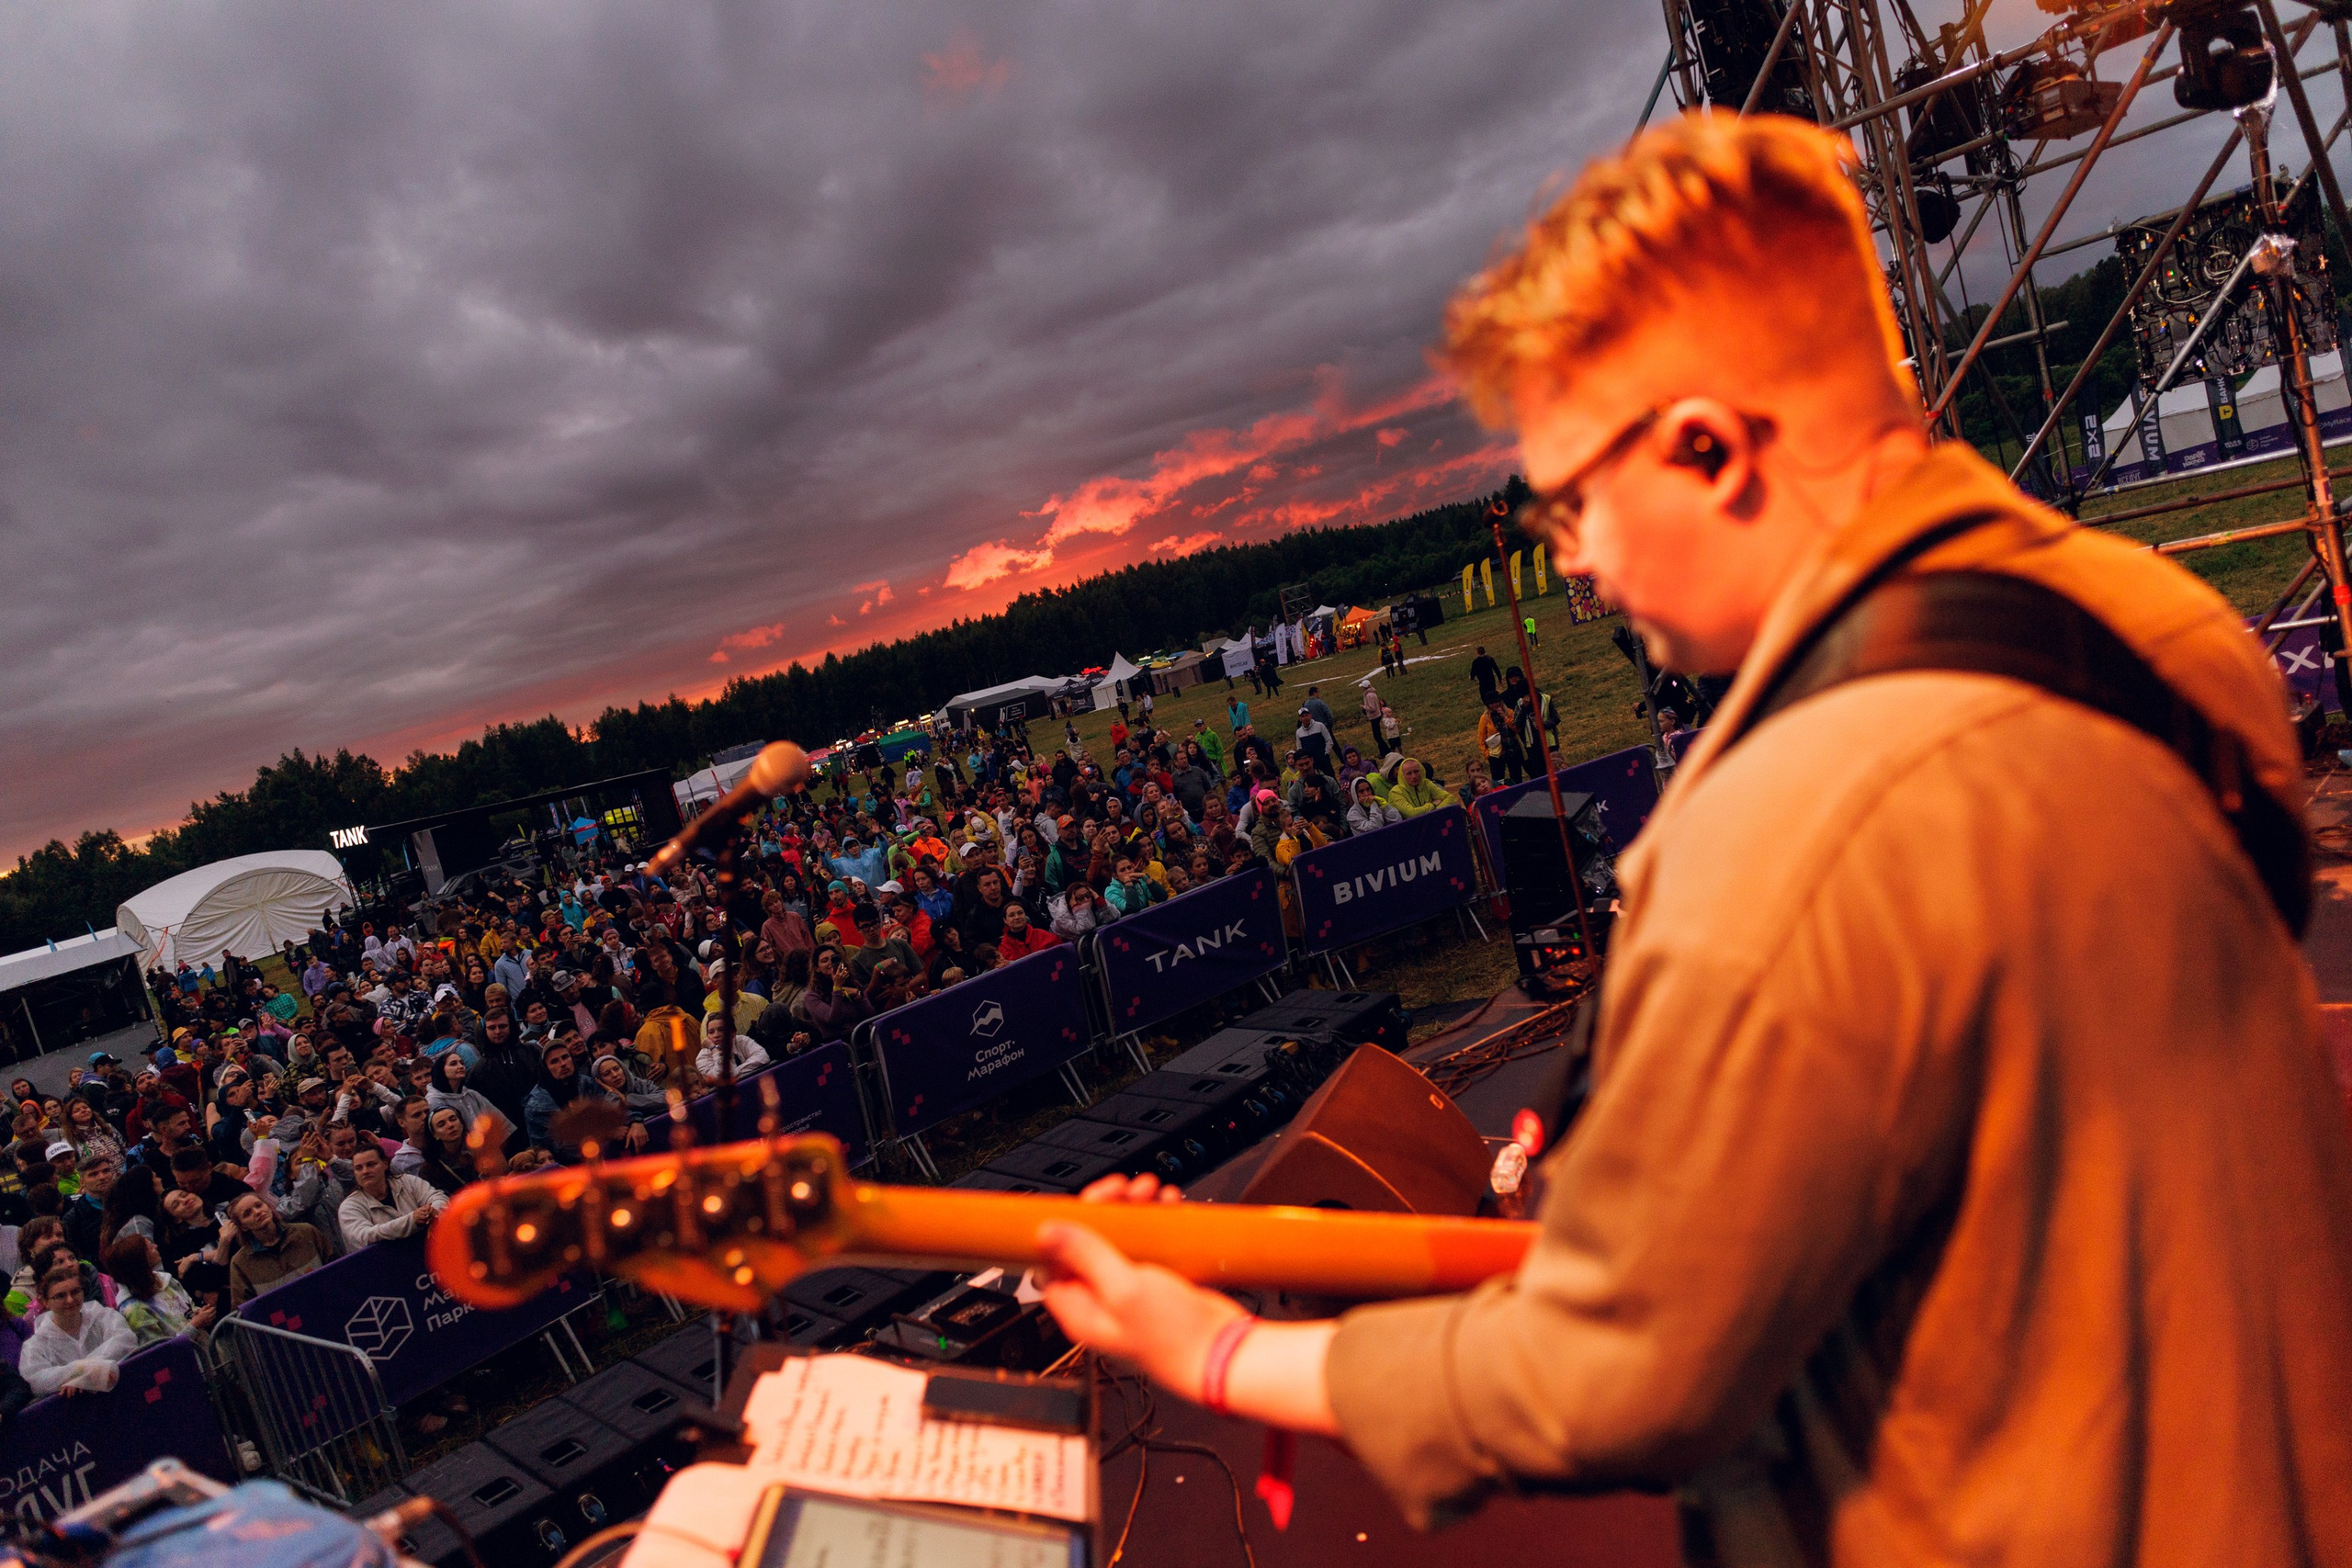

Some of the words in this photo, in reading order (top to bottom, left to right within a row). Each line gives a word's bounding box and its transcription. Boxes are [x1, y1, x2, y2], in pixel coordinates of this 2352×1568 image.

[2217, 377, 2228, 404] БАНК
[330, 825, 368, 850] TANK
[1332, 850, 1442, 907] BIVIUM
[1145, 918, 1248, 974] TANK
[580, 1017, 593, 1030] 14
[967, 1048, 1025, 1082] Марафон
[51, 1145, 68, 1155] ciele
[425, 1300, 475, 1332] Парк
